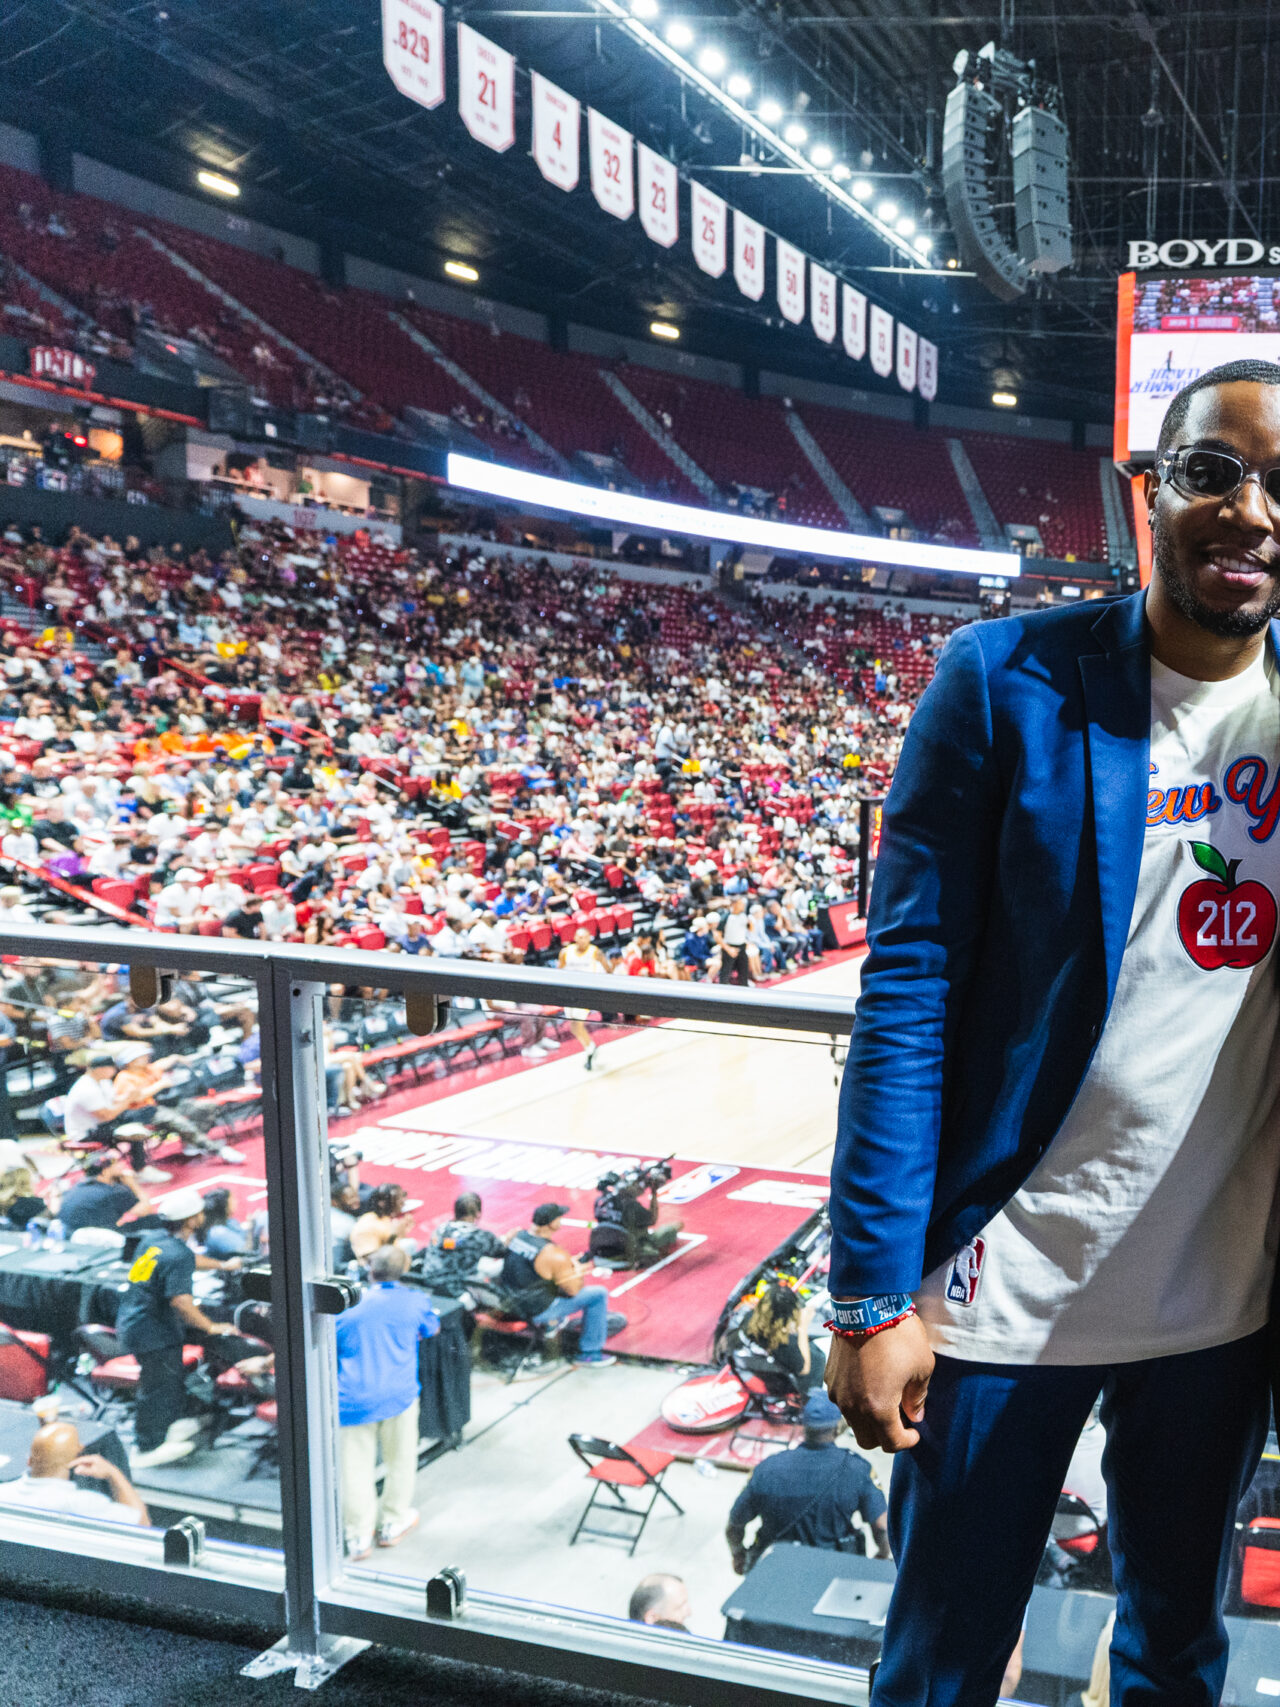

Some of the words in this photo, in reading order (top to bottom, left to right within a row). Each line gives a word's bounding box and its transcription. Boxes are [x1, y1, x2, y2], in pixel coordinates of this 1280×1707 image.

[478, 71, 496, 110] 21
[552, 121, 562, 150] 4
[603, 148, 621, 184] 32
[651, 181, 667, 214] 23
[1126, 238, 1265, 268] BOYD
[1146, 762, 1222, 827] ew
[1196, 900, 1258, 946] 212
[872, 1296, 889, 1311] JULY
[950, 1285, 965, 1299] NBA
[837, 1308, 865, 1324] GUEST
[878, 1304, 897, 1320] 2024
